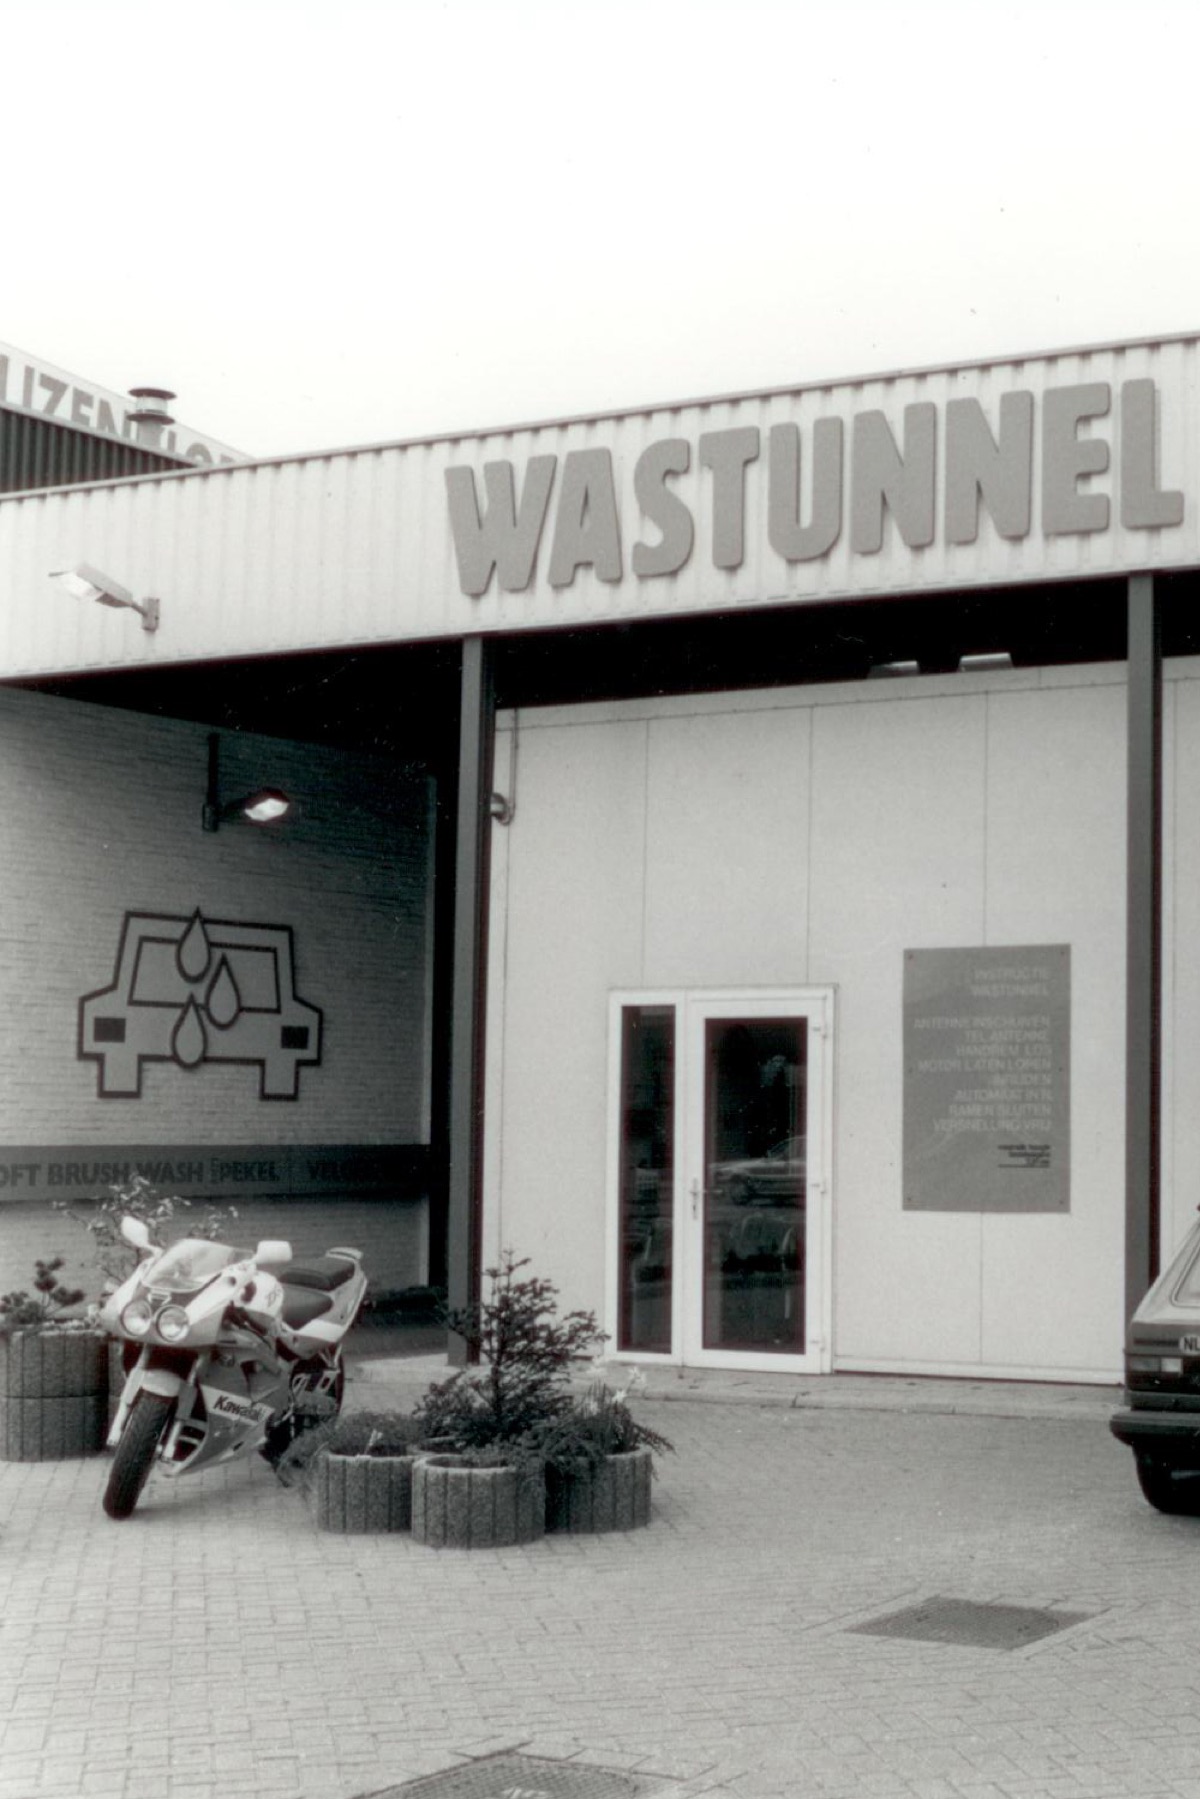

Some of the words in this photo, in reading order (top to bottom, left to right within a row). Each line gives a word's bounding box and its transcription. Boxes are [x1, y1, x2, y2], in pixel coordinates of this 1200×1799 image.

[444, 377, 1185, 597] WASTUNNEL
[48, 1162, 132, 1186] BRUSH
[135, 1161, 205, 1185] WASH
